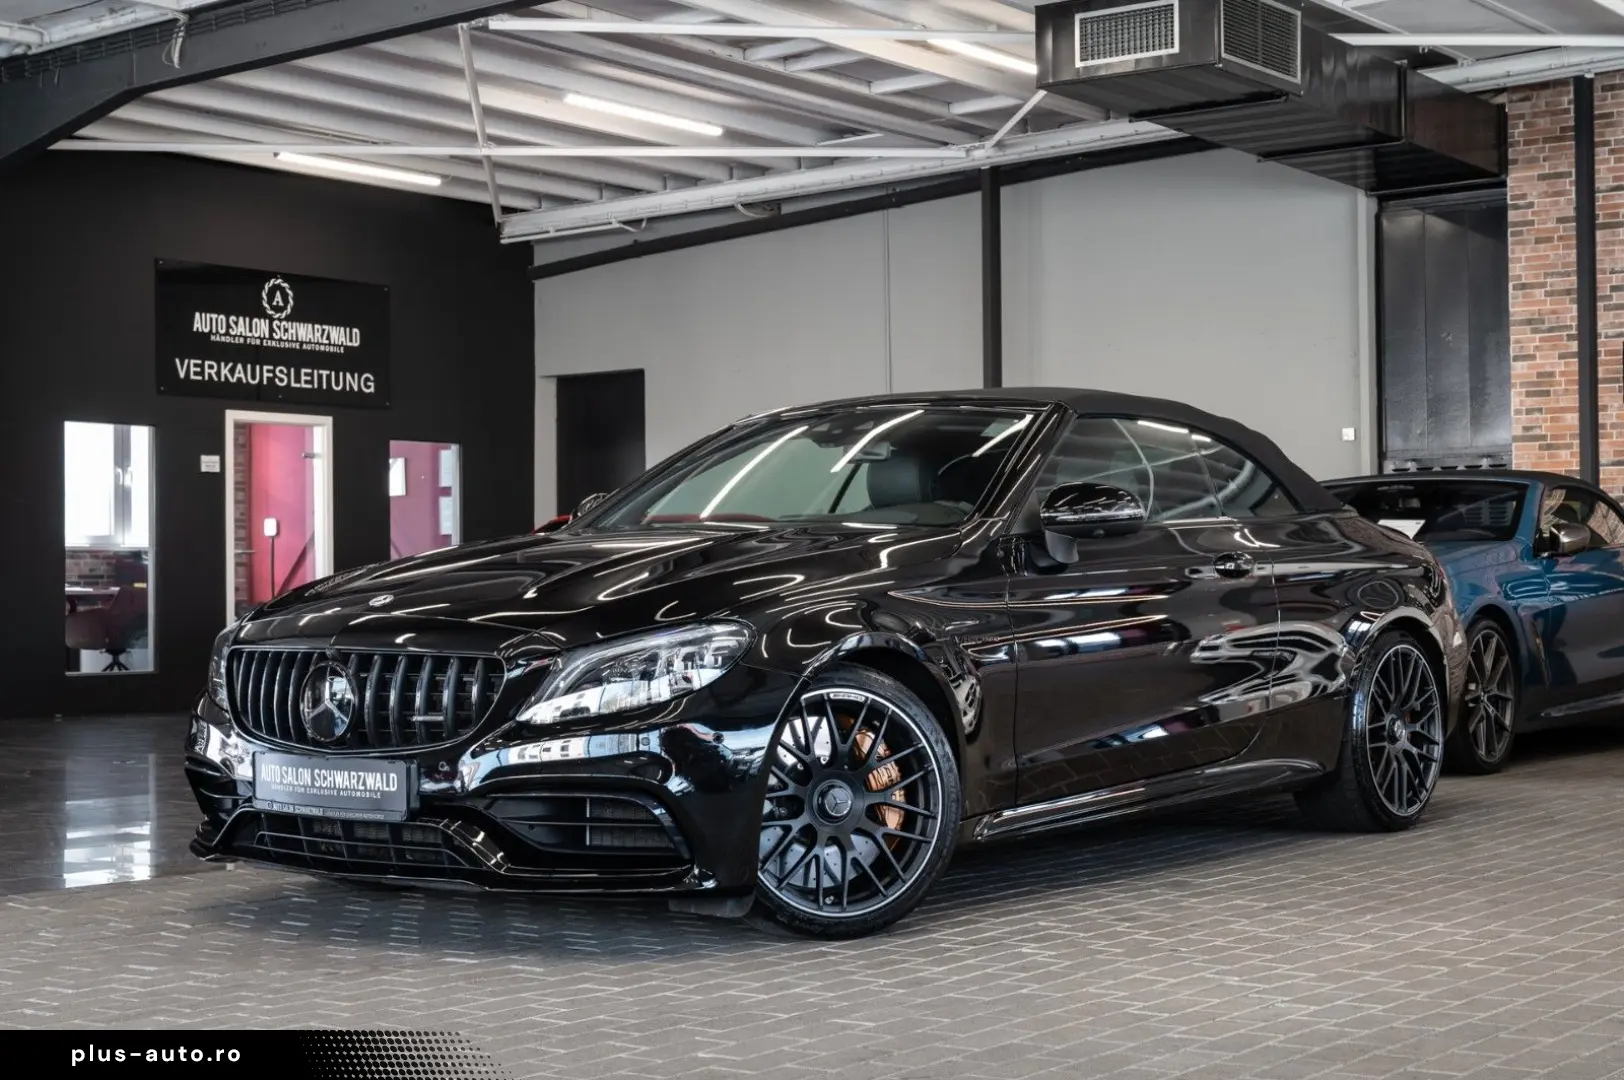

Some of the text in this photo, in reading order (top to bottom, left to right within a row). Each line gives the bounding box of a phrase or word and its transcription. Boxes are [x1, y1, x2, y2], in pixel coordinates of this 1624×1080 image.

[272, 290, 285, 307] A
[193, 311, 361, 347] AUTO SALON SCHWARZWALD
[210, 333, 345, 354] HÄNDLER FÜR EXKLUSIVE AUTOMOBILE
[175, 358, 375, 394] VERKAUFSLEITUNG
[261, 763, 398, 792] AUTO SALON SCHWARZWALD
[340, 789, 382, 799] AUTOMOBILE
